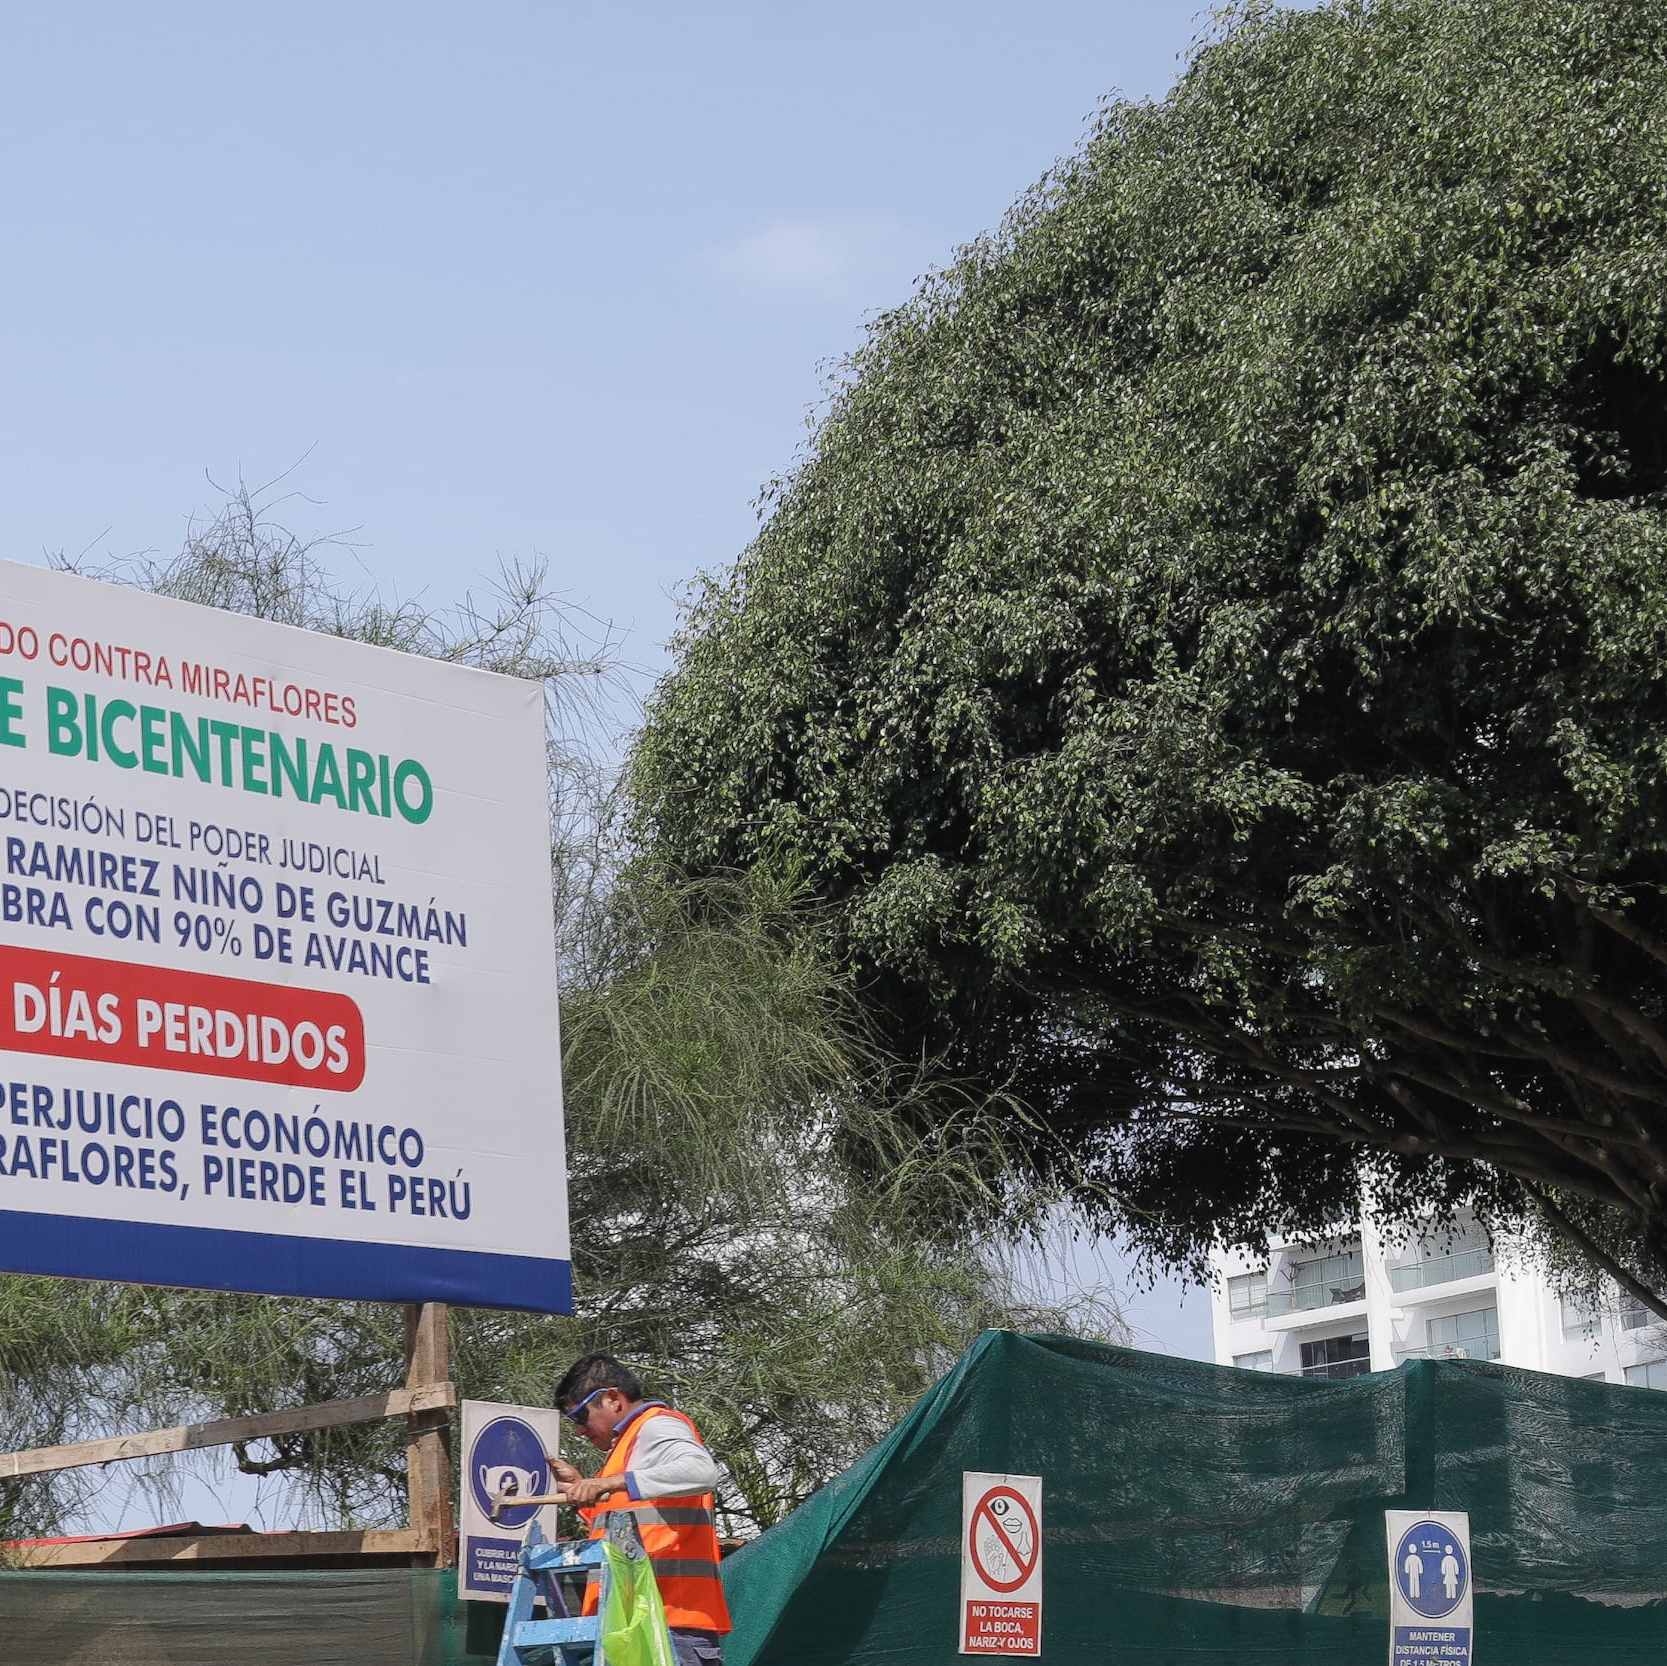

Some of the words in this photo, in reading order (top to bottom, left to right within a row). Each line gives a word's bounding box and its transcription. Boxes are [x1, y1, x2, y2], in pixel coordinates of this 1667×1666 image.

[49, 634, 173, 689] CONTRA
[182, 662, 356, 728] MIRAFLORES
[47, 686, 433, 825] BICENTENARIO
[136, 812, 181, 849] DEL
[190, 822, 272, 865] PODER
[279, 839, 385, 885] JUDICIAL
[7, 837, 160, 897] RAMIREZ
[173, 862, 263, 914] NIÑO
[276, 882, 315, 923] DE
[327, 891, 467, 947] GUZMÁN
[85, 897, 160, 944] CON
[174, 912, 242, 956] 90%
[254, 924, 292, 964] DE
[304, 933, 430, 984] AVANCE
[14, 972, 122, 1044] DÍAS
[137, 999, 349, 1073] PERDIDOS
[201, 1104, 424, 1168] ECONÓMICO
[203, 1155, 326, 1206] PIERDE
[340, 1168, 376, 1210] EL
[389, 1168, 471, 1220] PERÚ
[969, 1636, 997, 1648] NARIZ
[999, 1636, 1006, 1648] Y
[1007, 1637, 1034, 1649] OJOS
[972, 1605, 987, 1617] NO
[988, 1605, 1033, 1619] TOCARSE
[979, 1621, 993, 1633] LA
[994, 1621, 1024, 1635] BOCA,
[1409, 1631, 1456, 1642] MANTENER
[1395, 1645, 1439, 1655] DISTANCIA
[1440, 1644, 1468, 1656] FÍSICA
